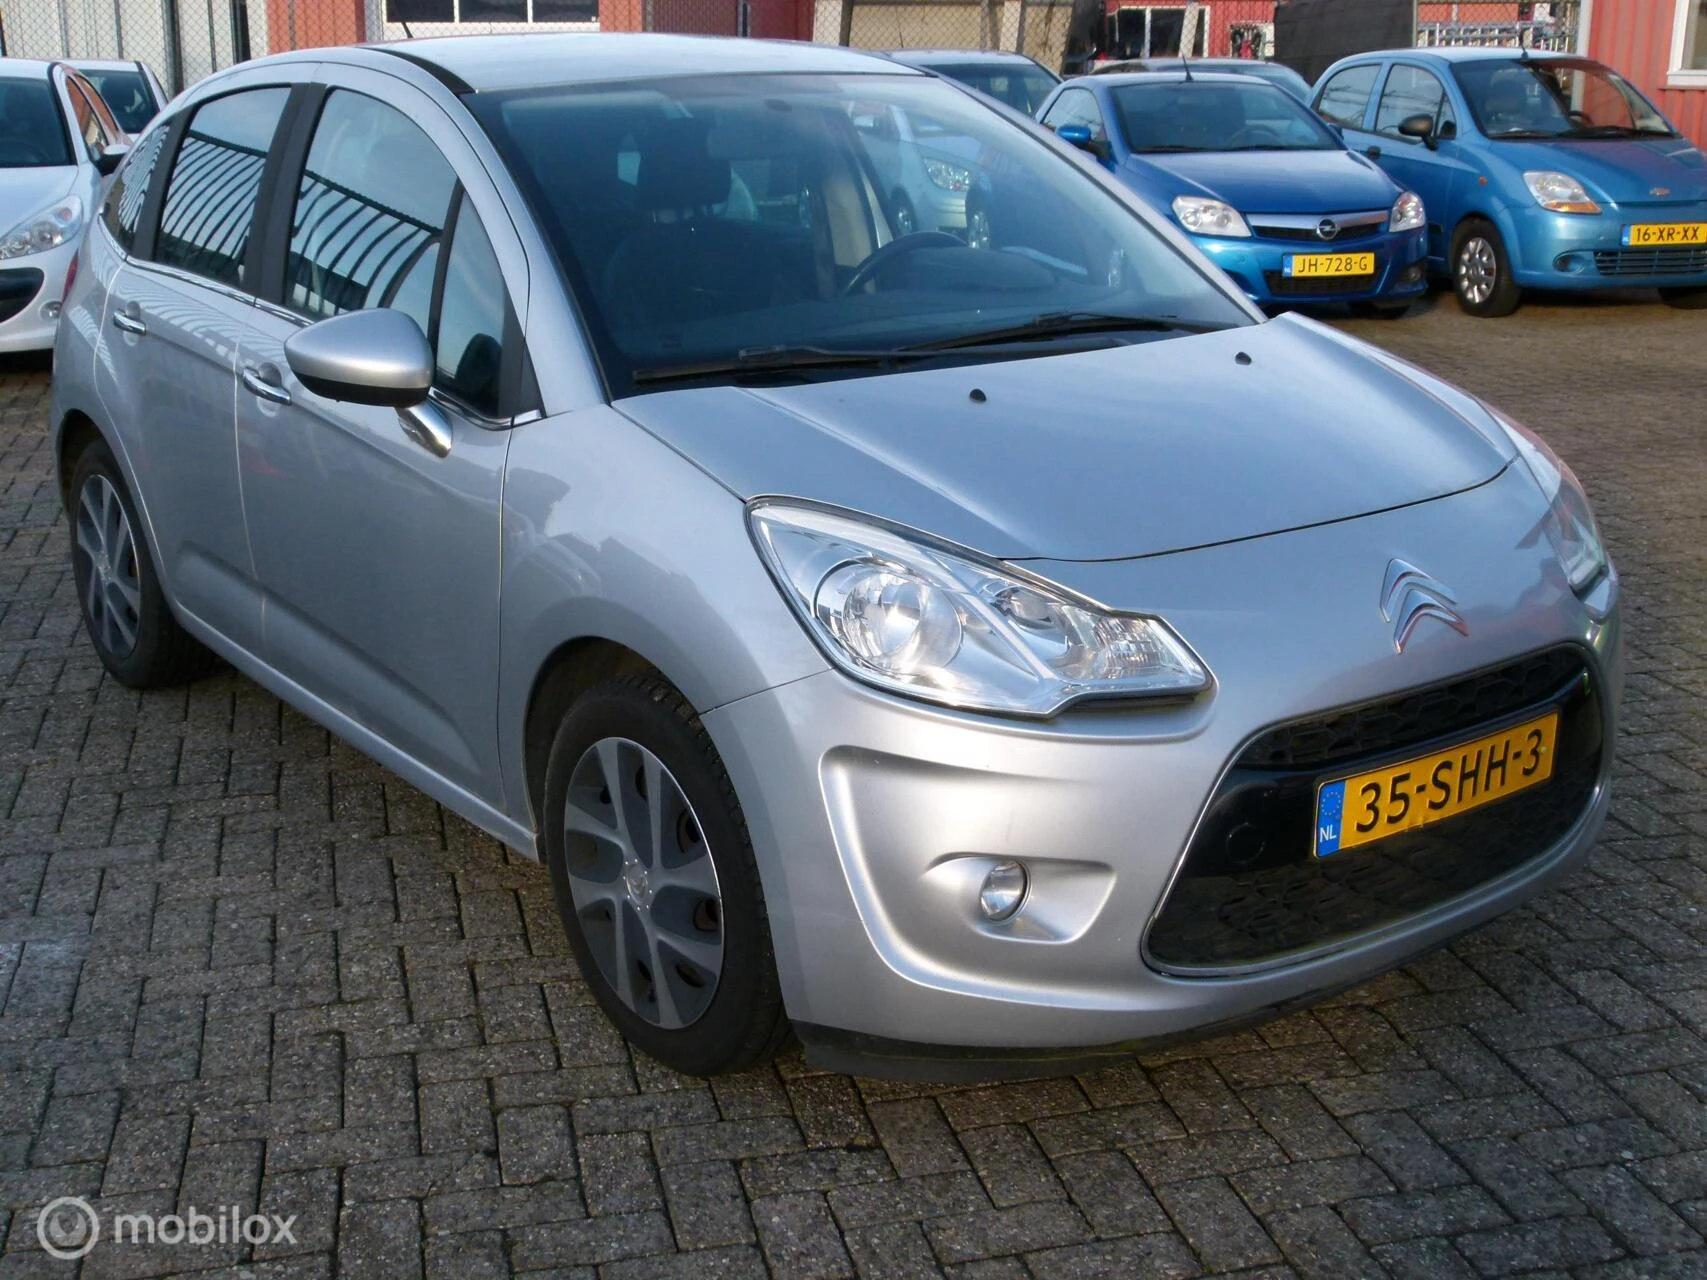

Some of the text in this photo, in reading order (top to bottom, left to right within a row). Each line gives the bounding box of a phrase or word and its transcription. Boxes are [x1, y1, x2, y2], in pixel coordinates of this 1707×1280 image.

[1636, 226, 1700, 242] 16-XR-XX
[1298, 256, 1368, 273] JH-728-G
[1355, 728, 1543, 833] 35-SHH-3
[1320, 824, 1337, 843] NL
